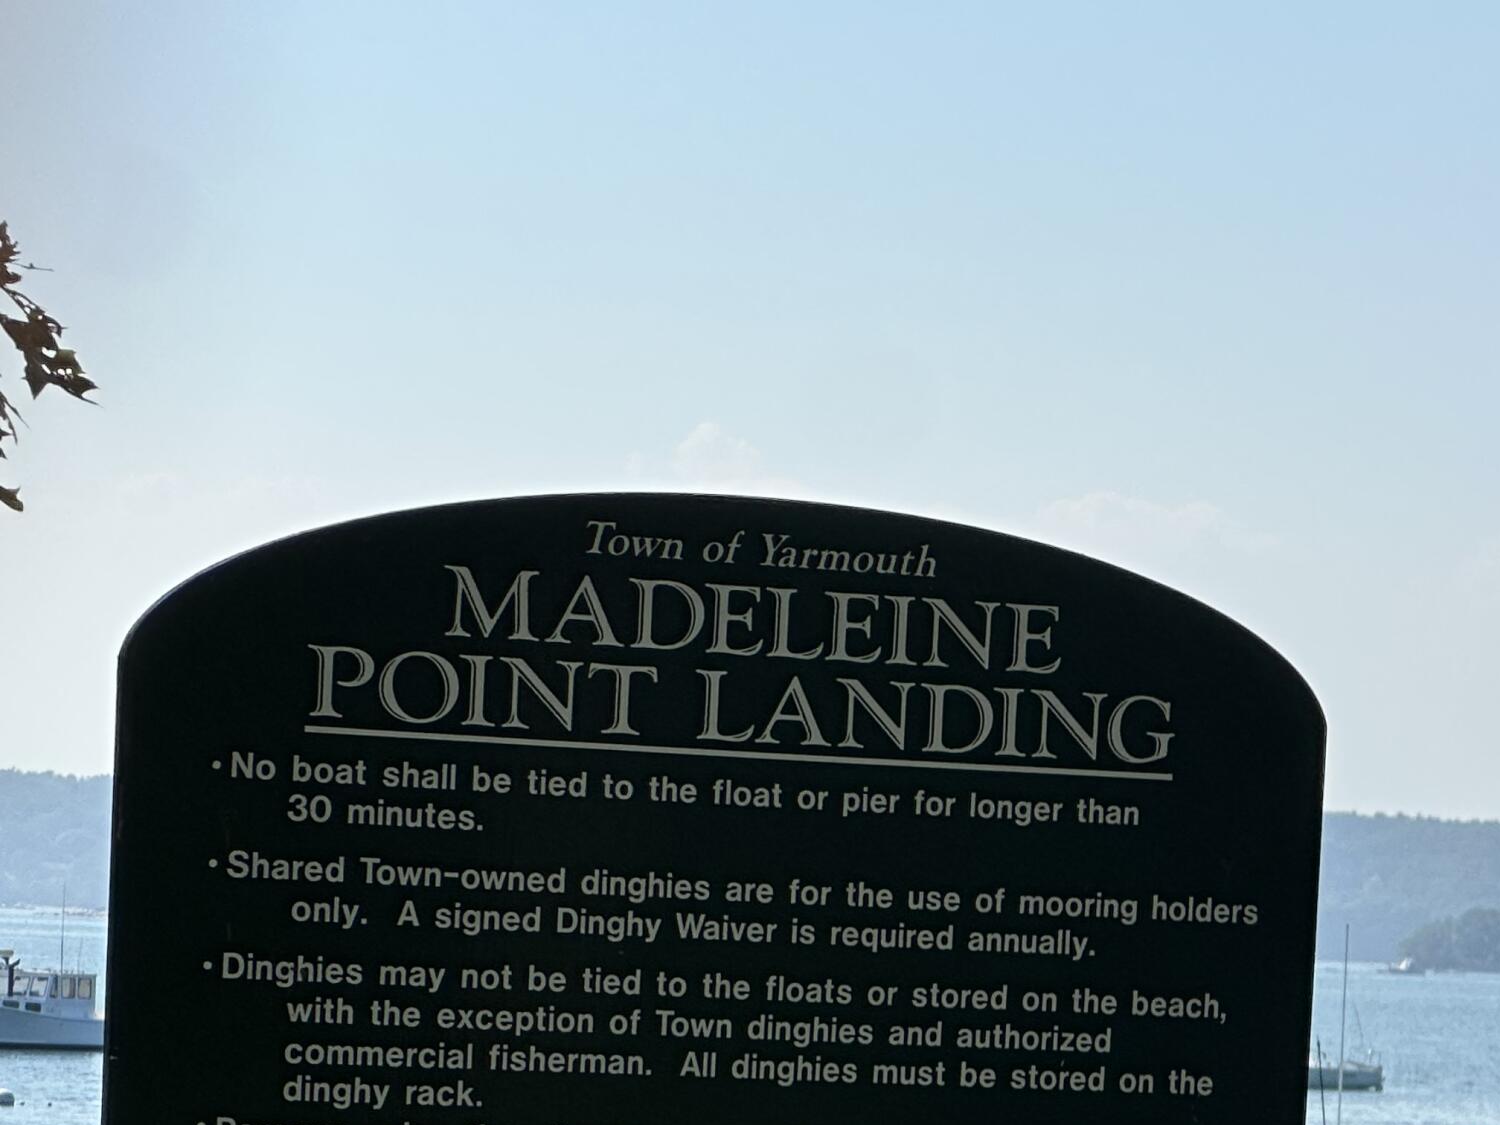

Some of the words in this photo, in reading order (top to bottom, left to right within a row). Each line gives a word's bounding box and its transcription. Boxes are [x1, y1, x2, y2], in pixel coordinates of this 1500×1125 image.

[585, 520, 684, 561] Town
[702, 530, 746, 564] of
[759, 533, 937, 578] Yarmouth
[443, 564, 1062, 675] MADELEINE
[307, 643, 659, 736] POINT
[695, 668, 1176, 764] LANDING
[230, 751, 277, 781] No
[292, 754, 367, 786] boat
[382, 760, 457, 791] shall
[472, 764, 512, 794] be
[527, 768, 588, 798] tied
[602, 773, 634, 801] to
[648, 775, 698, 804] the
[712, 778, 783, 809] float
[797, 789, 829, 811] or
[842, 786, 901, 818] pier
[913, 789, 957, 817] for
[969, 791, 1064, 827] longer
[1076, 797, 1140, 826] than
[287, 793, 333, 823] 30
[347, 798, 484, 832] minutes.
[226, 849, 345, 883] Shared
[359, 856, 566, 894] Town-owned
[580, 868, 710, 904] dinghies
[724, 881, 774, 904] are
[788, 878, 833, 906] for
[845, 881, 894, 909] the
[907, 890, 961, 912] use
[975, 887, 1006, 914] of
[1018, 891, 1138, 926] mooring
[1151, 894, 1258, 925] holders
[291, 895, 368, 930] only.
[396, 899, 420, 927] A
[434, 901, 542, 937] signed
[556, 906, 662, 943] Dinghy
[675, 911, 778, 943] Waiver
[791, 917, 816, 945] is
[830, 922, 954, 953] required
[967, 928, 1096, 961] annually.
[221, 951, 363, 988] Dinghies
[379, 965, 446, 994] may
[460, 964, 513, 991] not
[527, 964, 567, 993] be
[581, 966, 642, 996] tied
[656, 971, 687, 998] to
[702, 972, 751, 1001] the
[765, 975, 853, 1005] floats
[867, 985, 899, 1006] or
[911, 982, 1008, 1011] stored
[1022, 991, 1058, 1013] on
[1071, 987, 1118, 1015] the
[1131, 989, 1227, 1025] beach,
[286, 996, 354, 1025] with
[369, 999, 421, 1028] the
[436, 1005, 594, 1037] exception
[608, 1008, 642, 1036] of
[655, 1009, 733, 1039] Town
[747, 1013, 874, 1048] dinghies
[888, 1020, 943, 1047] and
[956, 1023, 1112, 1054] authorized
[282, 1074, 391, 1110] dinghy
[405, 1079, 483, 1108] rack.
[284, 1041, 474, 1070] commercial
[488, 1043, 652, 1076] fisherman.
[679, 1050, 717, 1078] All
[731, 1052, 858, 1087] dinghies
[872, 1061, 946, 1087] must
[959, 1060, 997, 1089] be
[1010, 1064, 1106, 1092] stored
[1119, 1072, 1154, 1094] on
[1168, 1068, 1214, 1097] the
